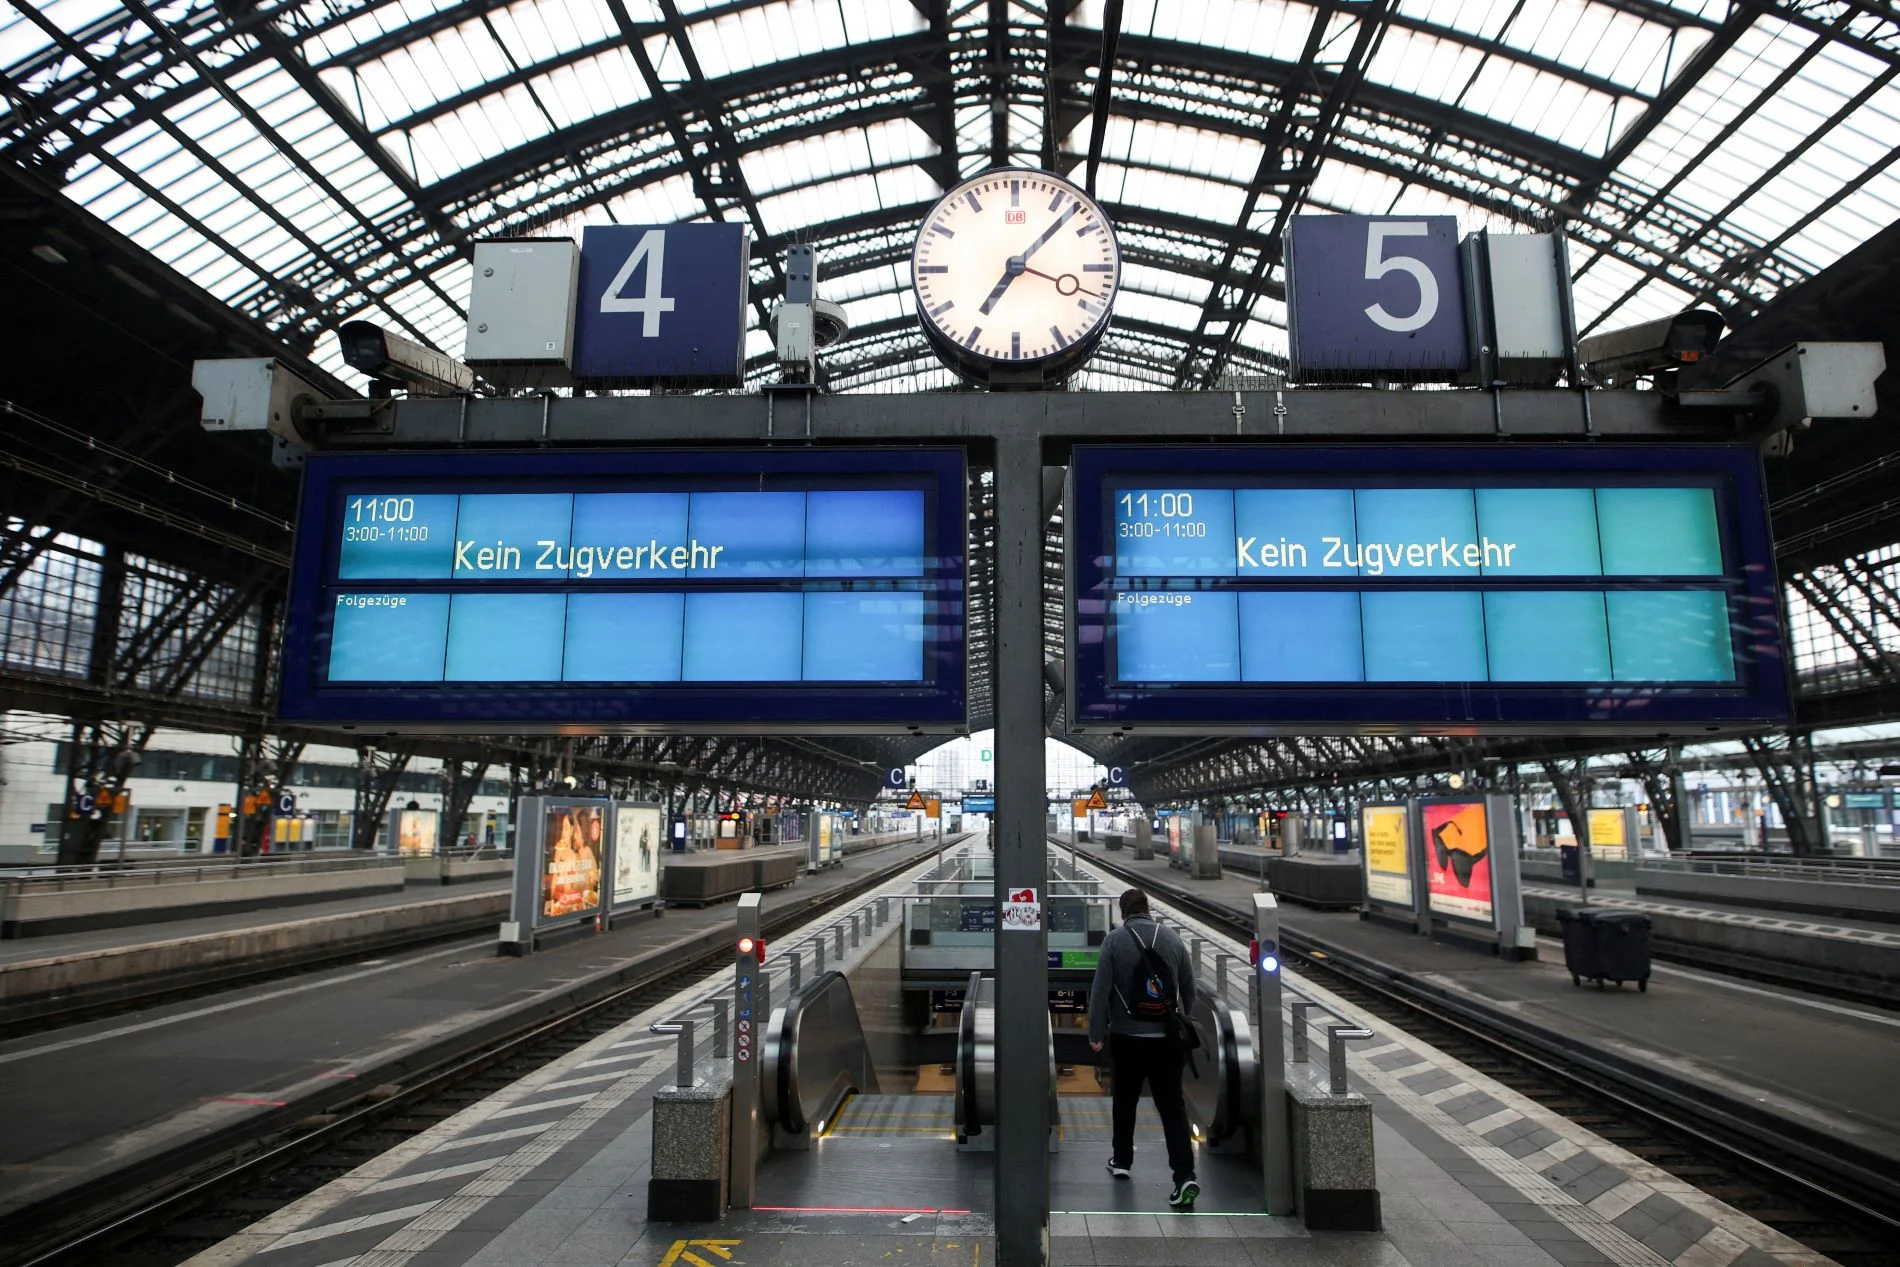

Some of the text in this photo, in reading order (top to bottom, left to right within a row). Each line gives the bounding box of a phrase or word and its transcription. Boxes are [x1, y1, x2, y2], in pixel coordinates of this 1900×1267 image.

[1007, 212, 1023, 222] DB
[600, 229, 675, 338] 4
[1364, 221, 1440, 332] 5
[350, 498, 414, 522] 11:00
[1120, 493, 1193, 517] 11:00
[346, 527, 428, 542] 3:00-11:00
[1119, 522, 1206, 538] 3:00-11:00
[454, 540, 724, 578] Kein Zugverkehr
[1237, 537, 1516, 575] Kein Zugverkehr
[337, 594, 407, 609] Folgezüge
[1118, 593, 1192, 606] Folgezüge
[981, 749, 992, 762] D
[890, 768, 903, 785] C
[1110, 767, 1123, 784] C
[80, 796, 93, 811] C
[280, 795, 293, 812] C
